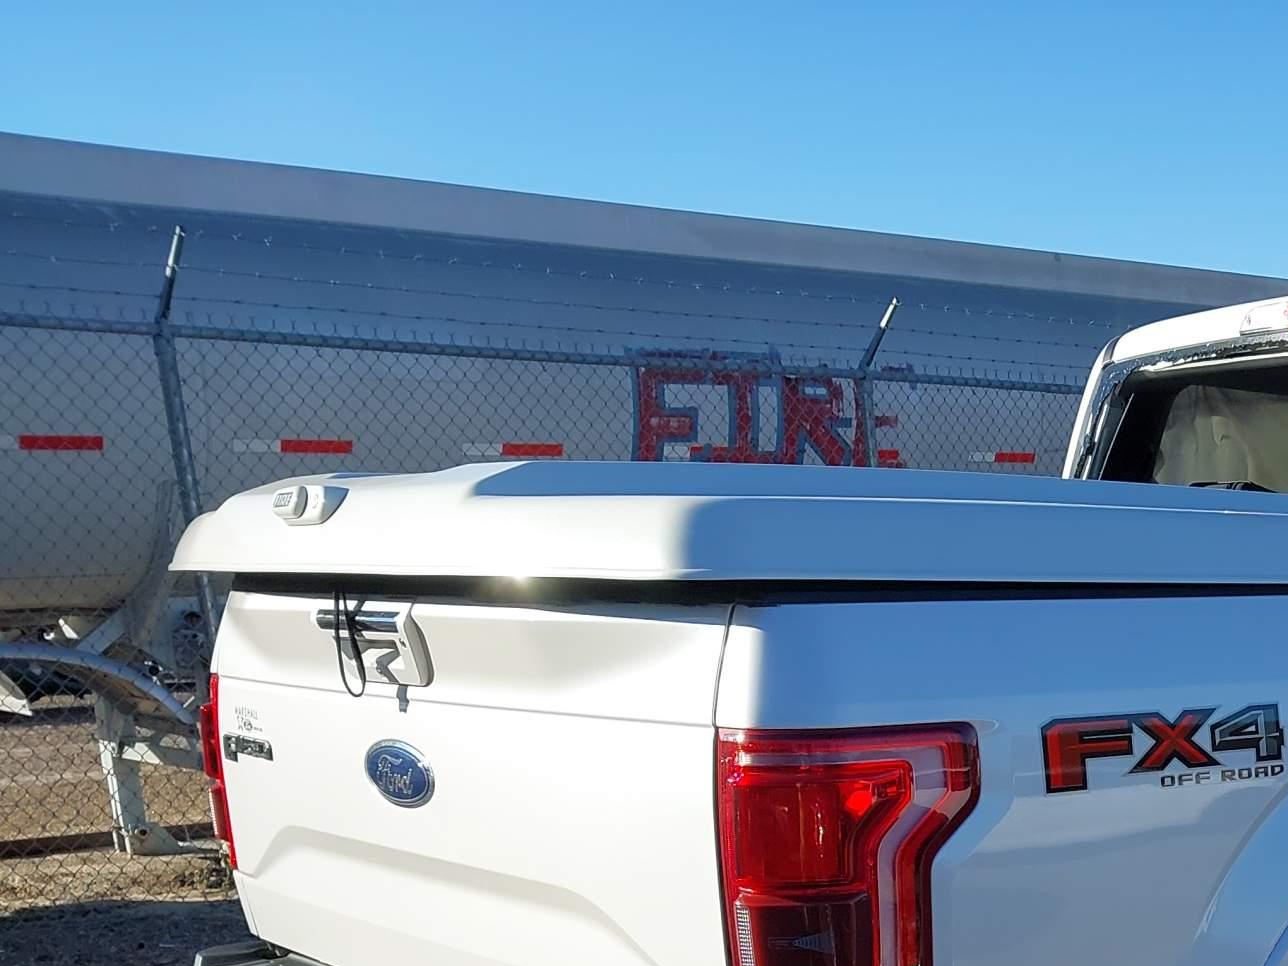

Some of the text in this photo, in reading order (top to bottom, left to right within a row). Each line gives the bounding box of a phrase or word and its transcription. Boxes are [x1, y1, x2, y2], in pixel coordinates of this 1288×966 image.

[1041, 703, 1286, 794] FX4
[376, 754, 414, 795] Ford
[1160, 764, 1285, 788] OFF ROAD
